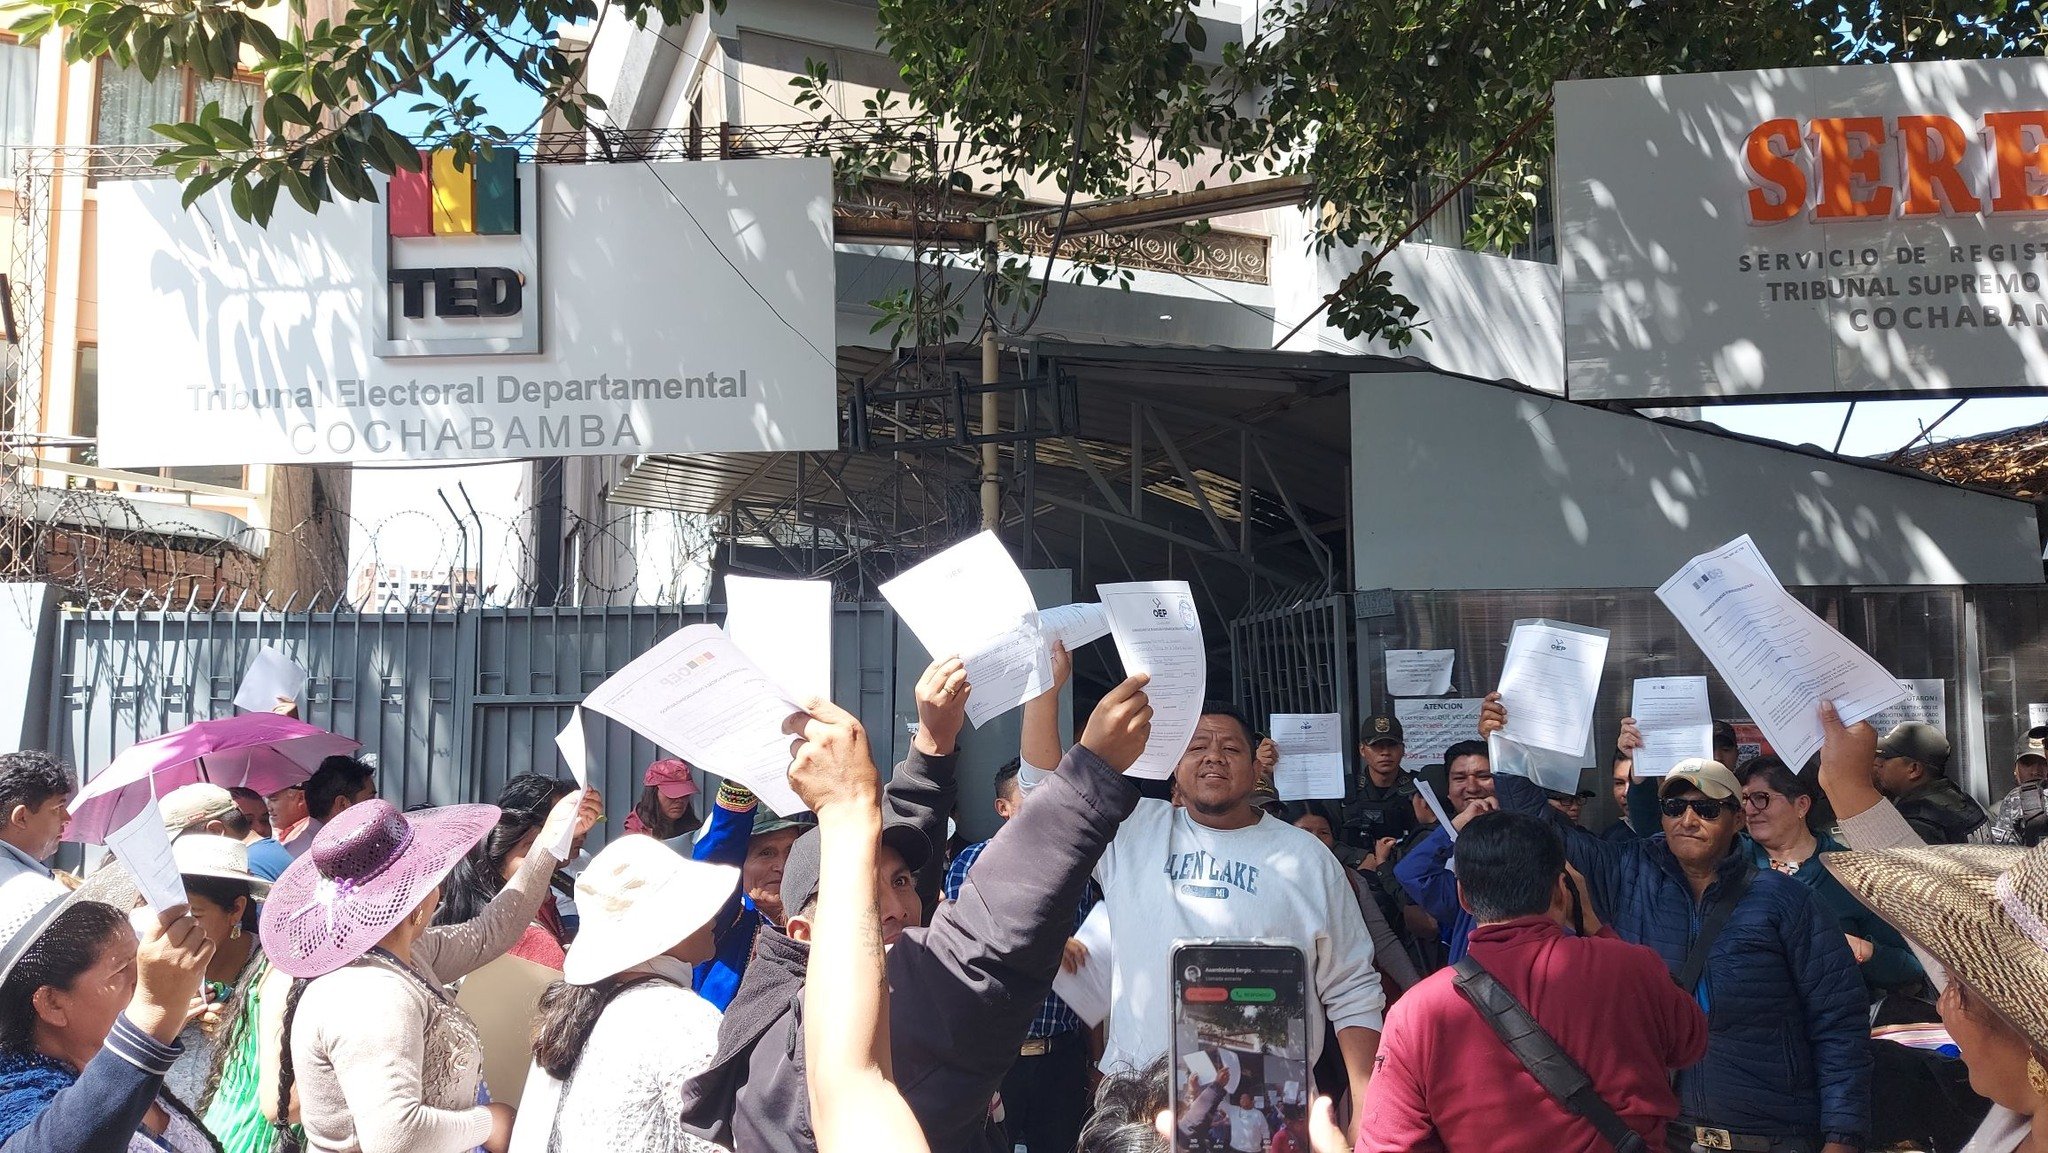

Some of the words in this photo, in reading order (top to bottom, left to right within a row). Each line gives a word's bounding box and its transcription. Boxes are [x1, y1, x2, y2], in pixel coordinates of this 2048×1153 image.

[1743, 110, 2048, 225] SERE
[1739, 249, 1879, 272] SERVICIO
[1897, 247, 1926, 265] DE
[389, 267, 522, 318] TED
[1767, 277, 1900, 302] TRIBUNAL
[1908, 272, 2041, 296] SUPREMO
[187, 380, 323, 410] Tribunal
[336, 376, 484, 408] Electoral
[497, 370, 747, 409] Departamental
[291, 413, 641, 455] COCHABAMBA
[1152, 609, 1167, 618] OEP
[1209, 857, 1260, 896] LAKE
